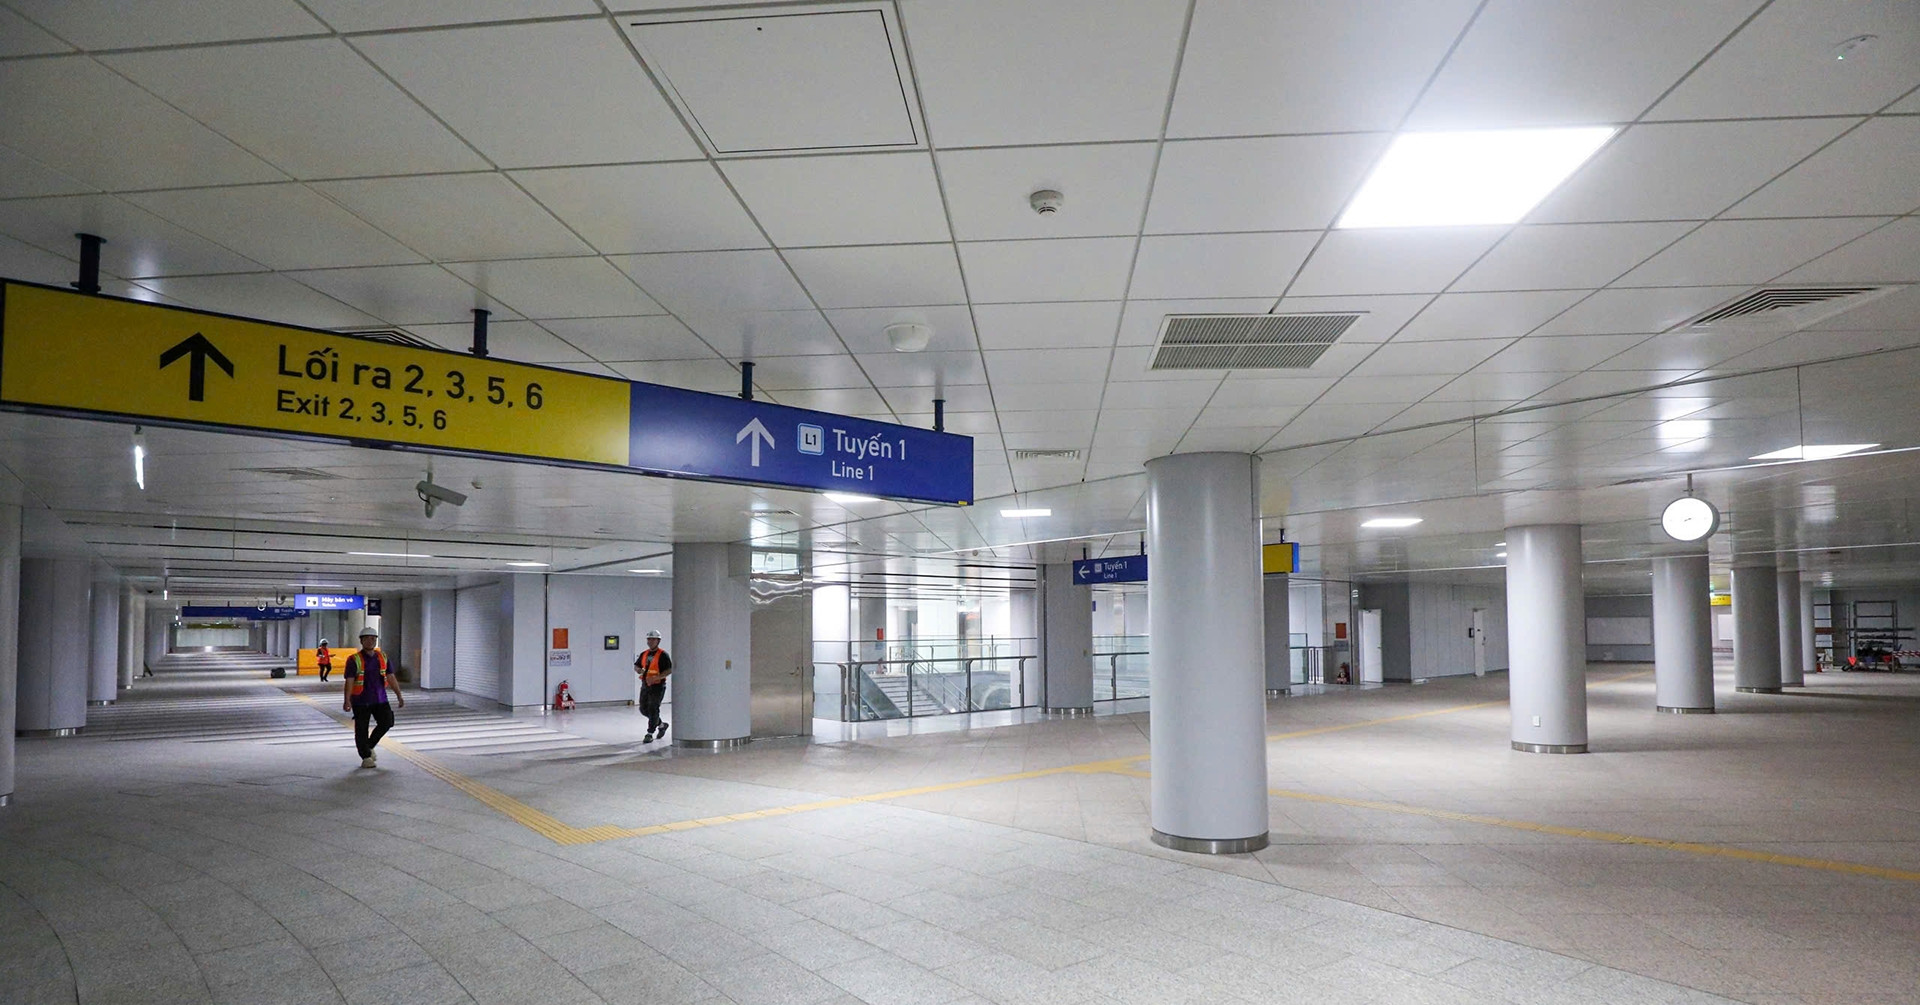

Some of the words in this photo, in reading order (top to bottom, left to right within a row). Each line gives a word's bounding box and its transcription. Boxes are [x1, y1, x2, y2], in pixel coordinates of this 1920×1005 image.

[278, 344, 339, 382] Lối
[353, 363, 391, 390] ra
[404, 364, 433, 398] 2,
[446, 370, 474, 403] 3,
[487, 376, 513, 408] 5,
[526, 383, 543, 410] 6
[277, 389, 330, 417] Exit
[339, 397, 361, 422] 2,
[371, 401, 393, 426] 3,
[403, 405, 423, 429] 5,
[433, 409, 446, 430] 6
[805, 433, 817, 445] L1
[832, 428, 892, 460] Tuyến
[899, 439, 906, 460] 1
[832, 460, 864, 480] Line
[868, 465, 874, 481] 1
[1104, 560, 1123, 572] Tuyến
